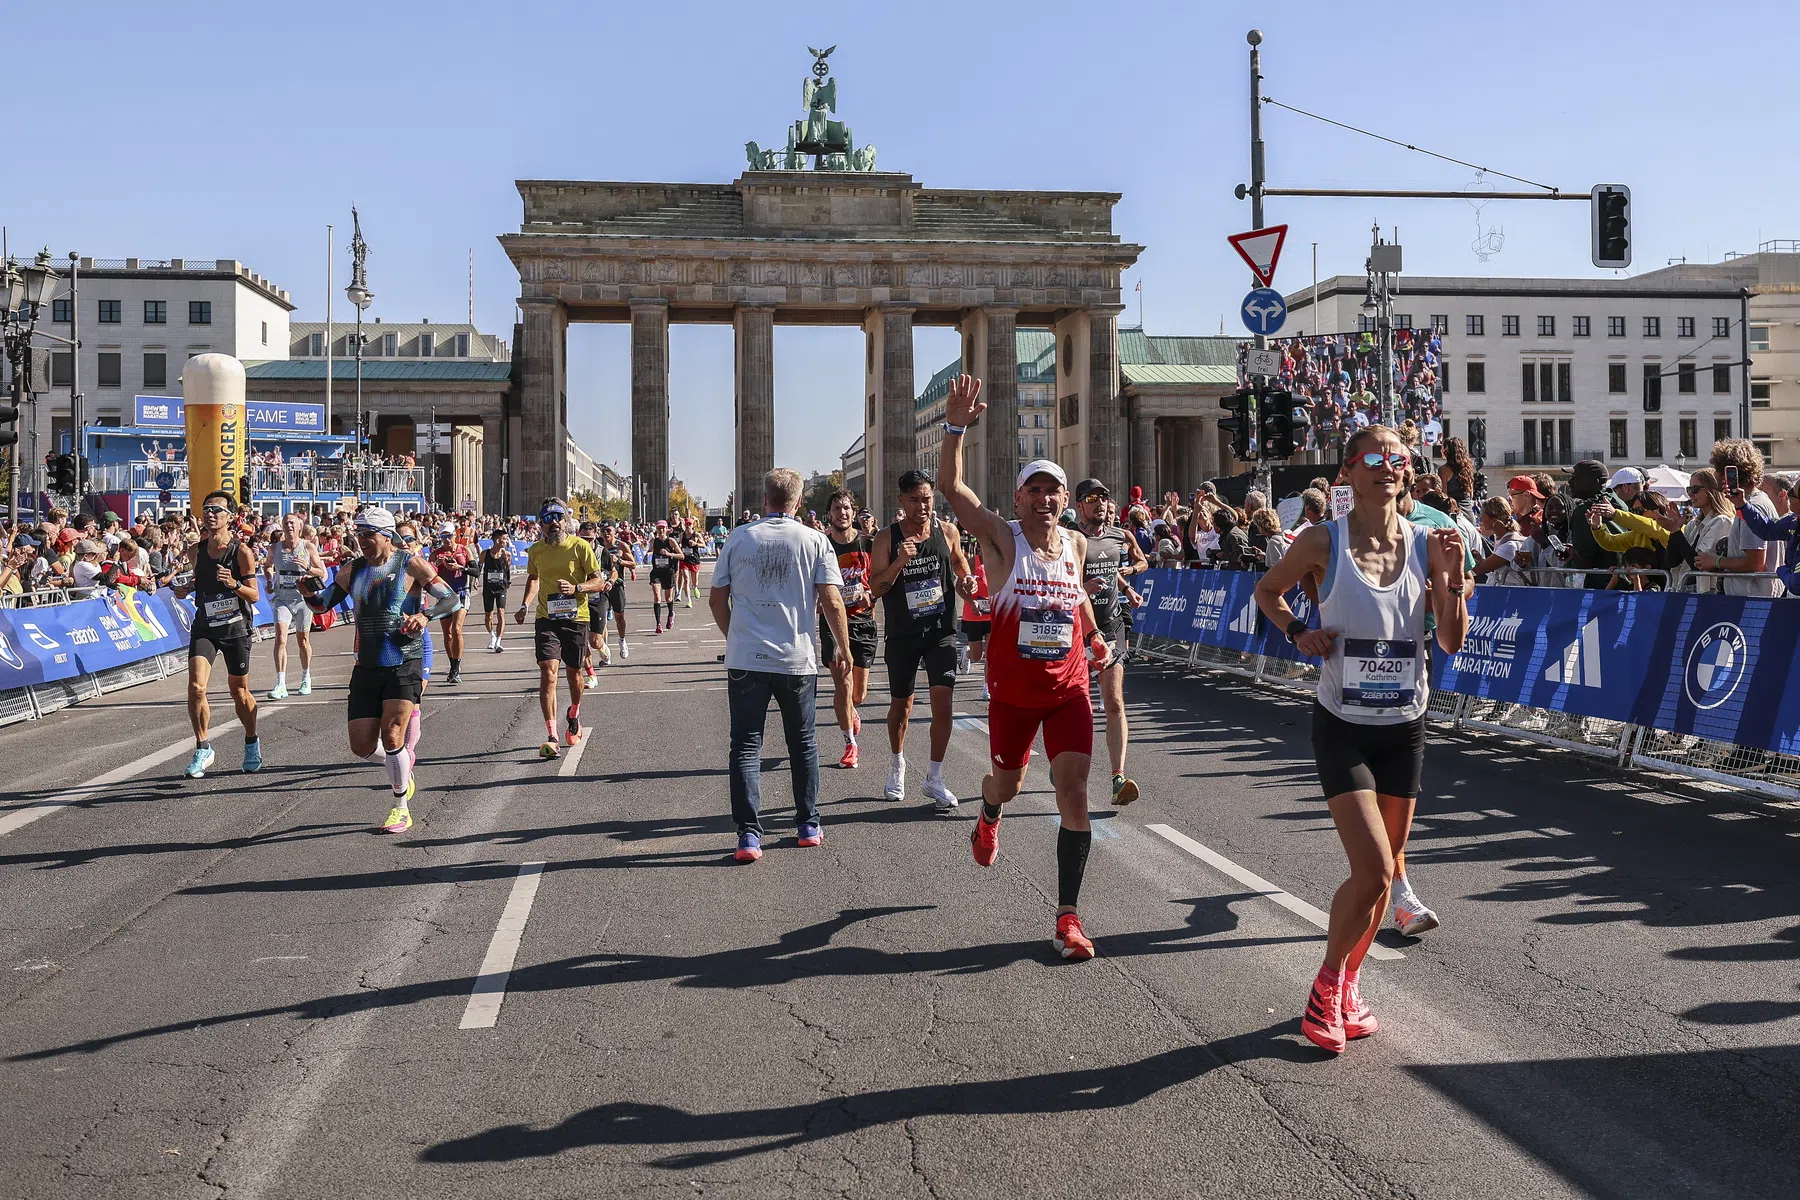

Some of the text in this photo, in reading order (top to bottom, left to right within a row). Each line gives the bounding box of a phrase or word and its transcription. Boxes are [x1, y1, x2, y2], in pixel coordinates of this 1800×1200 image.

[246, 409, 288, 423] FAME
[902, 560, 941, 577] Running Club
[914, 589, 936, 599] 24019
[1013, 577, 1078, 600] AUSTRIA
[1158, 594, 1187, 613] zalando
[1198, 588, 1216, 605] BMW
[212, 599, 233, 609] 67882
[1195, 605, 1213, 618] BERLIN
[98, 615, 119, 630] BMW
[1031, 624, 1063, 634] 31897
[1191, 618, 1219, 631] MARATHON
[66, 625, 100, 646] zalando
[1701, 626, 1743, 651] BMW
[1031, 647, 1060, 655] zalando
[1459, 637, 1493, 656] ERLIN
[1359, 660, 1403, 673] 70420
[1451, 655, 1512, 679] MARATHON
[1365, 673, 1397, 681] Kathrina
[1361, 691, 1399, 699] zalando
